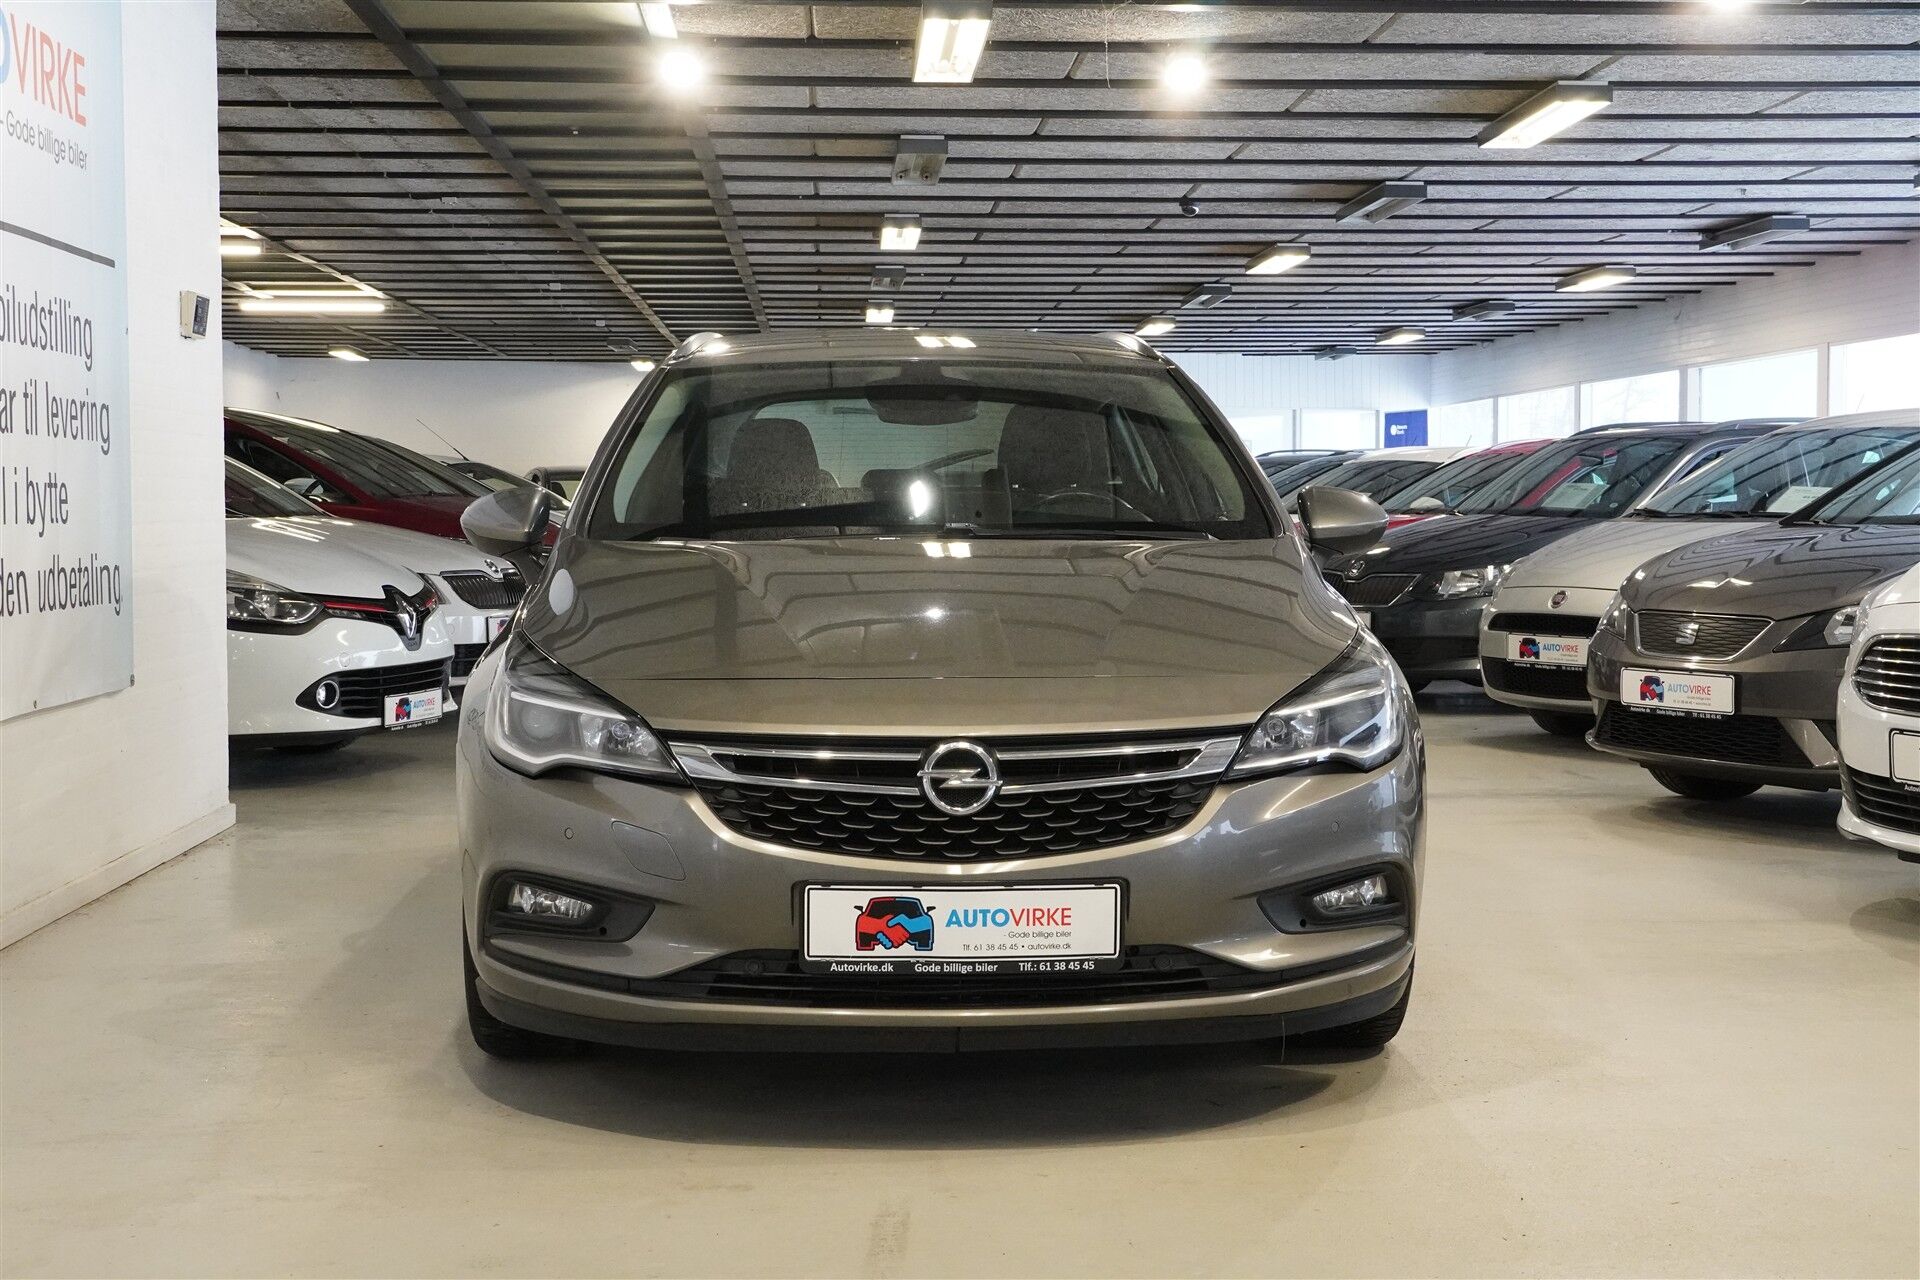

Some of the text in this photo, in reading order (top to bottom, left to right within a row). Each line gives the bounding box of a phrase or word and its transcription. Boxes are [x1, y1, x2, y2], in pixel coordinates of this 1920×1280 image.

[6, 109, 88, 170] Gode billige biler
[23, 379, 38, 435] til
[46, 381, 110, 455] levering
[26, 466, 69, 538] bytte
[38, 553, 121, 616] udbetaling
[1542, 643, 1579, 653] AUTOVIRKE
[1667, 683, 1712, 696] AUTOVIRKE
[945, 907, 1072, 928] AUTOVIRKE
[1008, 931, 1031, 939] Gode
[1032, 930, 1054, 939] billige
[1027, 942, 1072, 951] autovirke.dk
[830, 961, 1095, 974] Autovirke.dk Gode billige biler Tlf.: 61 38 45 45
